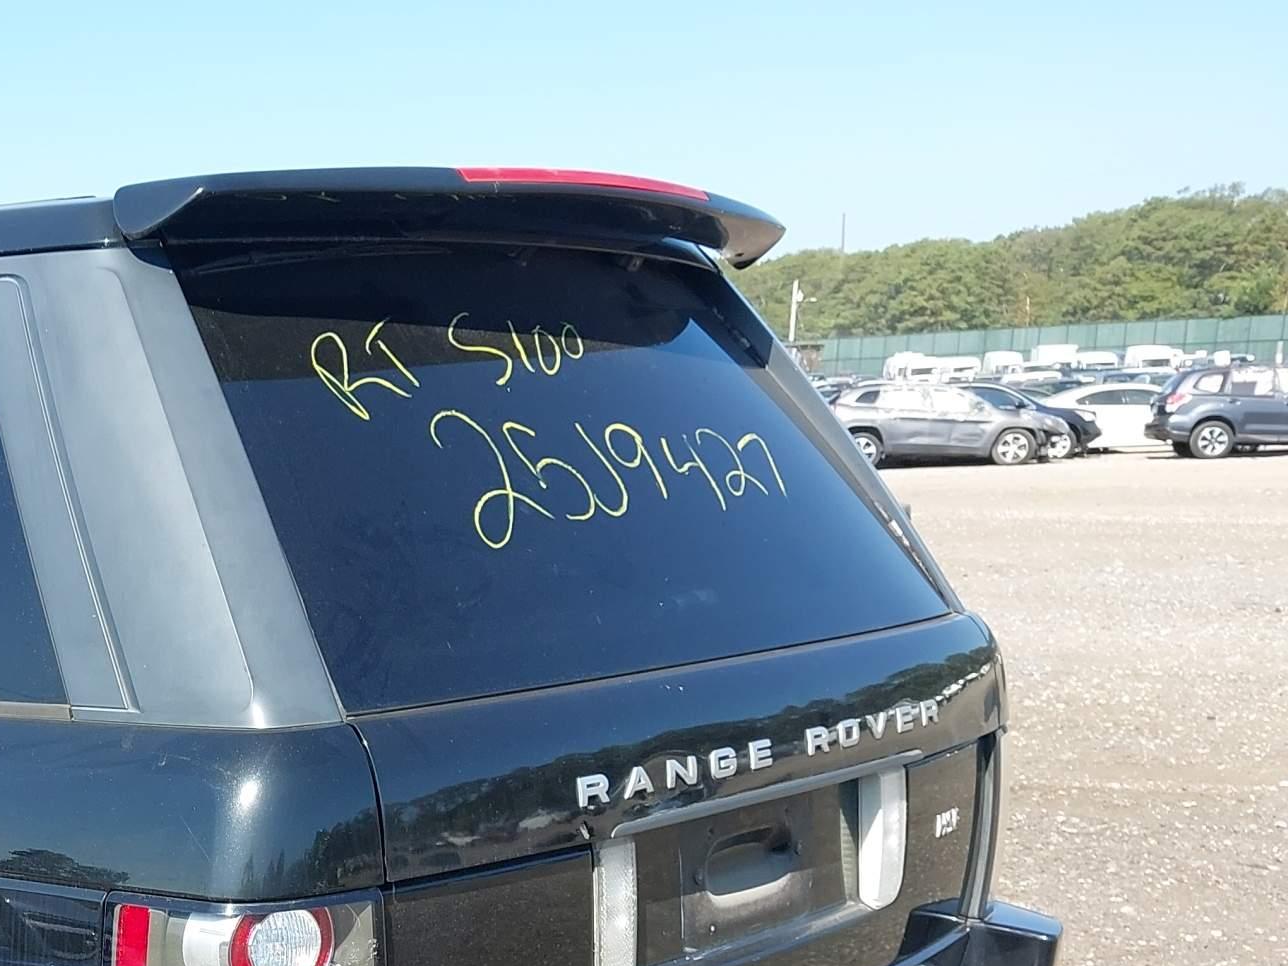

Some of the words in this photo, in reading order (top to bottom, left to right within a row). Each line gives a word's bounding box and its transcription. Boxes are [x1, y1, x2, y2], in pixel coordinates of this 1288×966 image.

[310, 317, 420, 421] RT
[447, 312, 585, 388] S100
[576, 737, 775, 810] RANGE
[805, 698, 940, 757] ROVER
